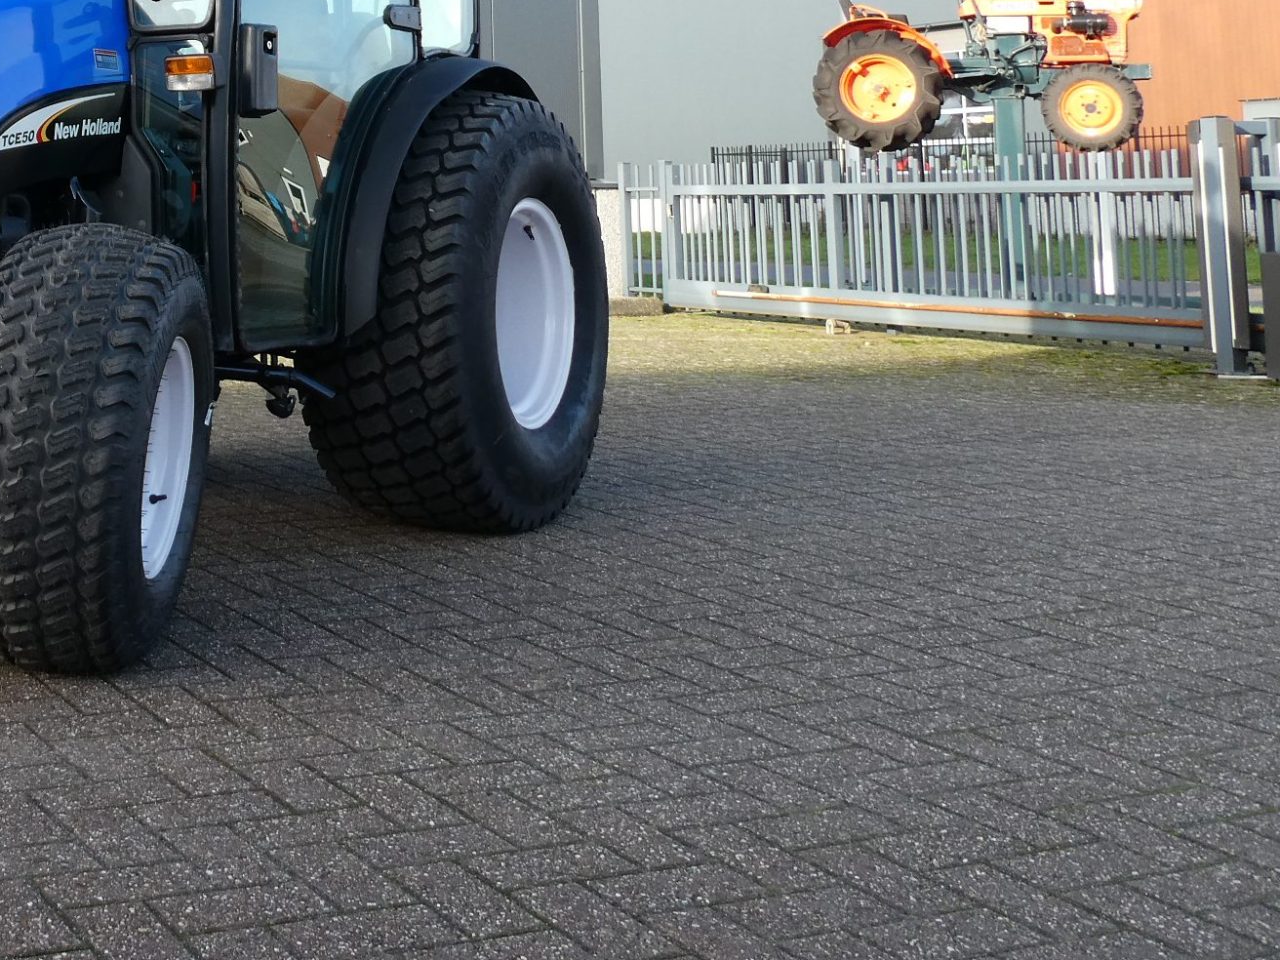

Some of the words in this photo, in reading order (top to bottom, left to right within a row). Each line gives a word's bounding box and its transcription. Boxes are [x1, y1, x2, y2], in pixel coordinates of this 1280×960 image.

[1, 130, 35, 147] TCE50
[53, 122, 79, 141] New
[81, 116, 122, 137] Holland
